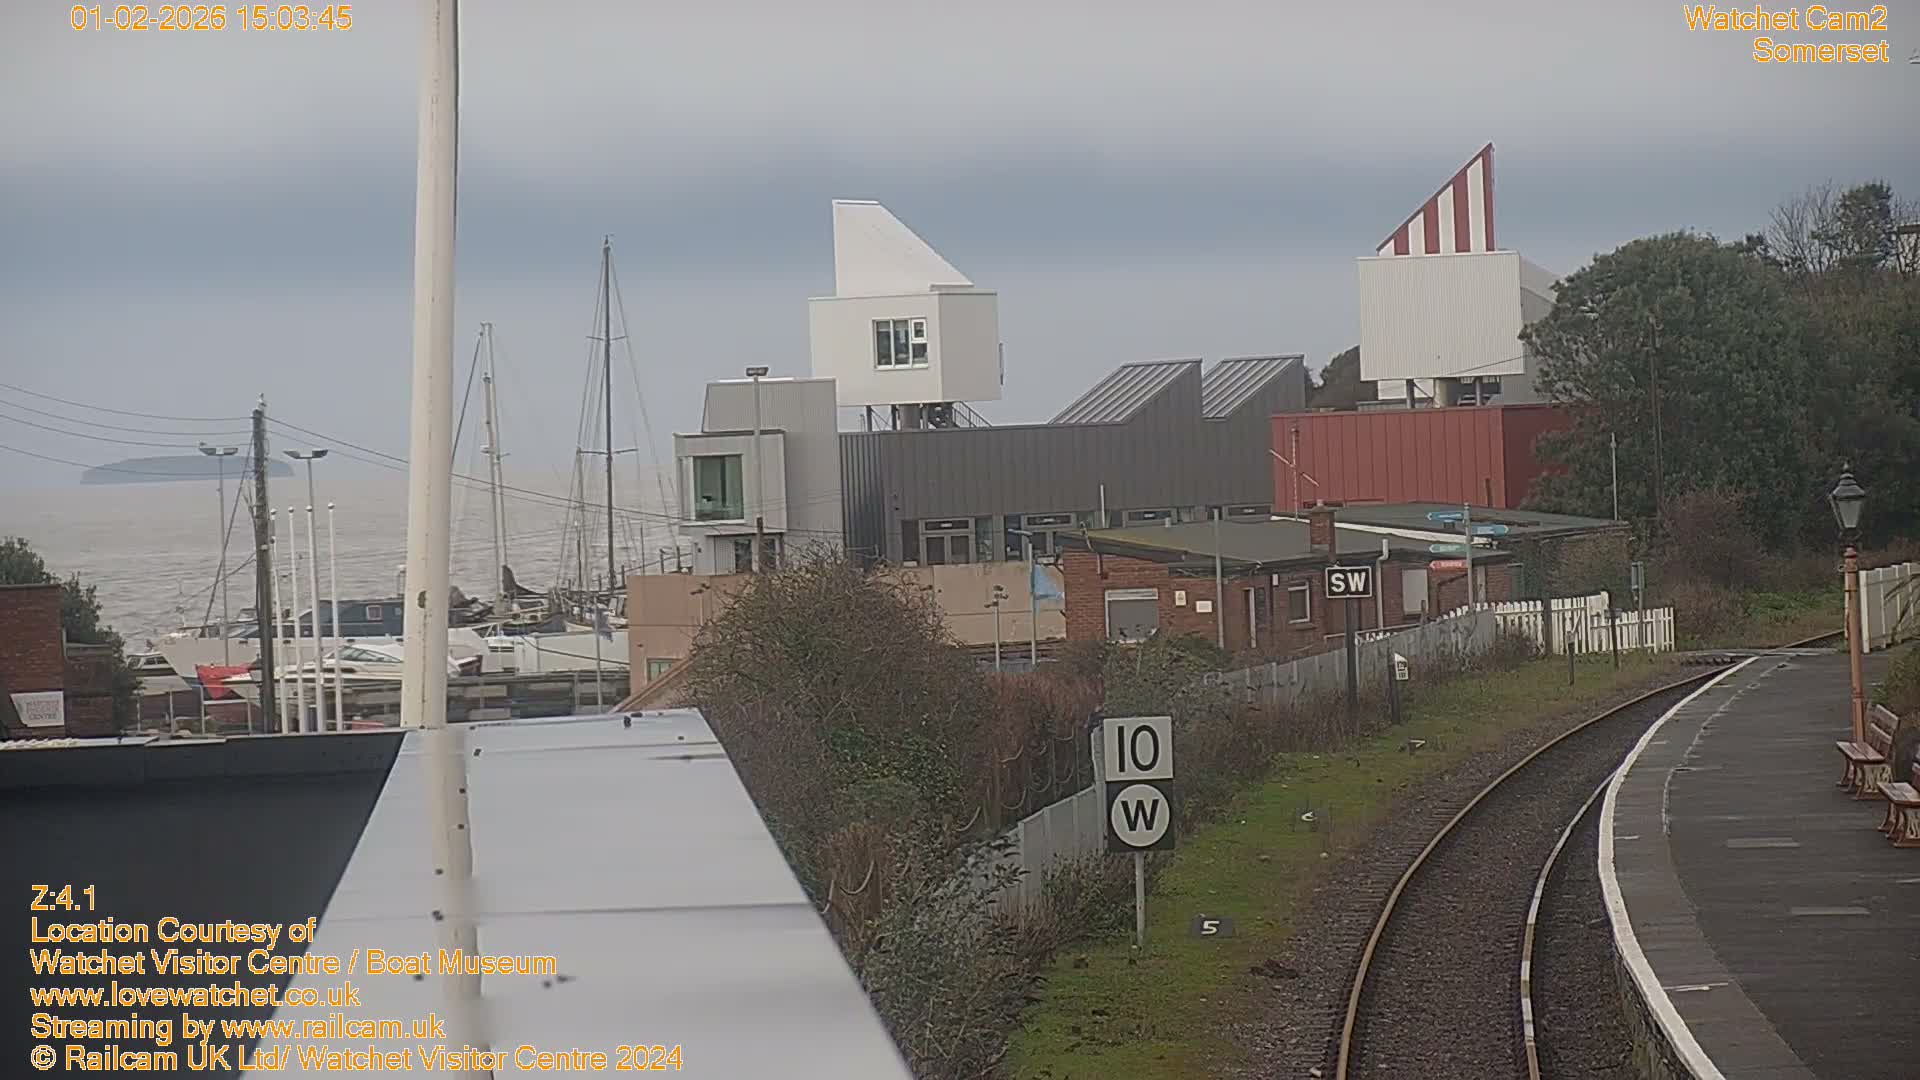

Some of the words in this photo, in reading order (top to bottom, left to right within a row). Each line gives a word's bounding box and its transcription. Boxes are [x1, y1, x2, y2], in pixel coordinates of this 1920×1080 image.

[1331, 572, 1366, 592] SW
[1118, 725, 1160, 772] 10
[1120, 799, 1160, 832] W
[1201, 920, 1220, 935] 5
